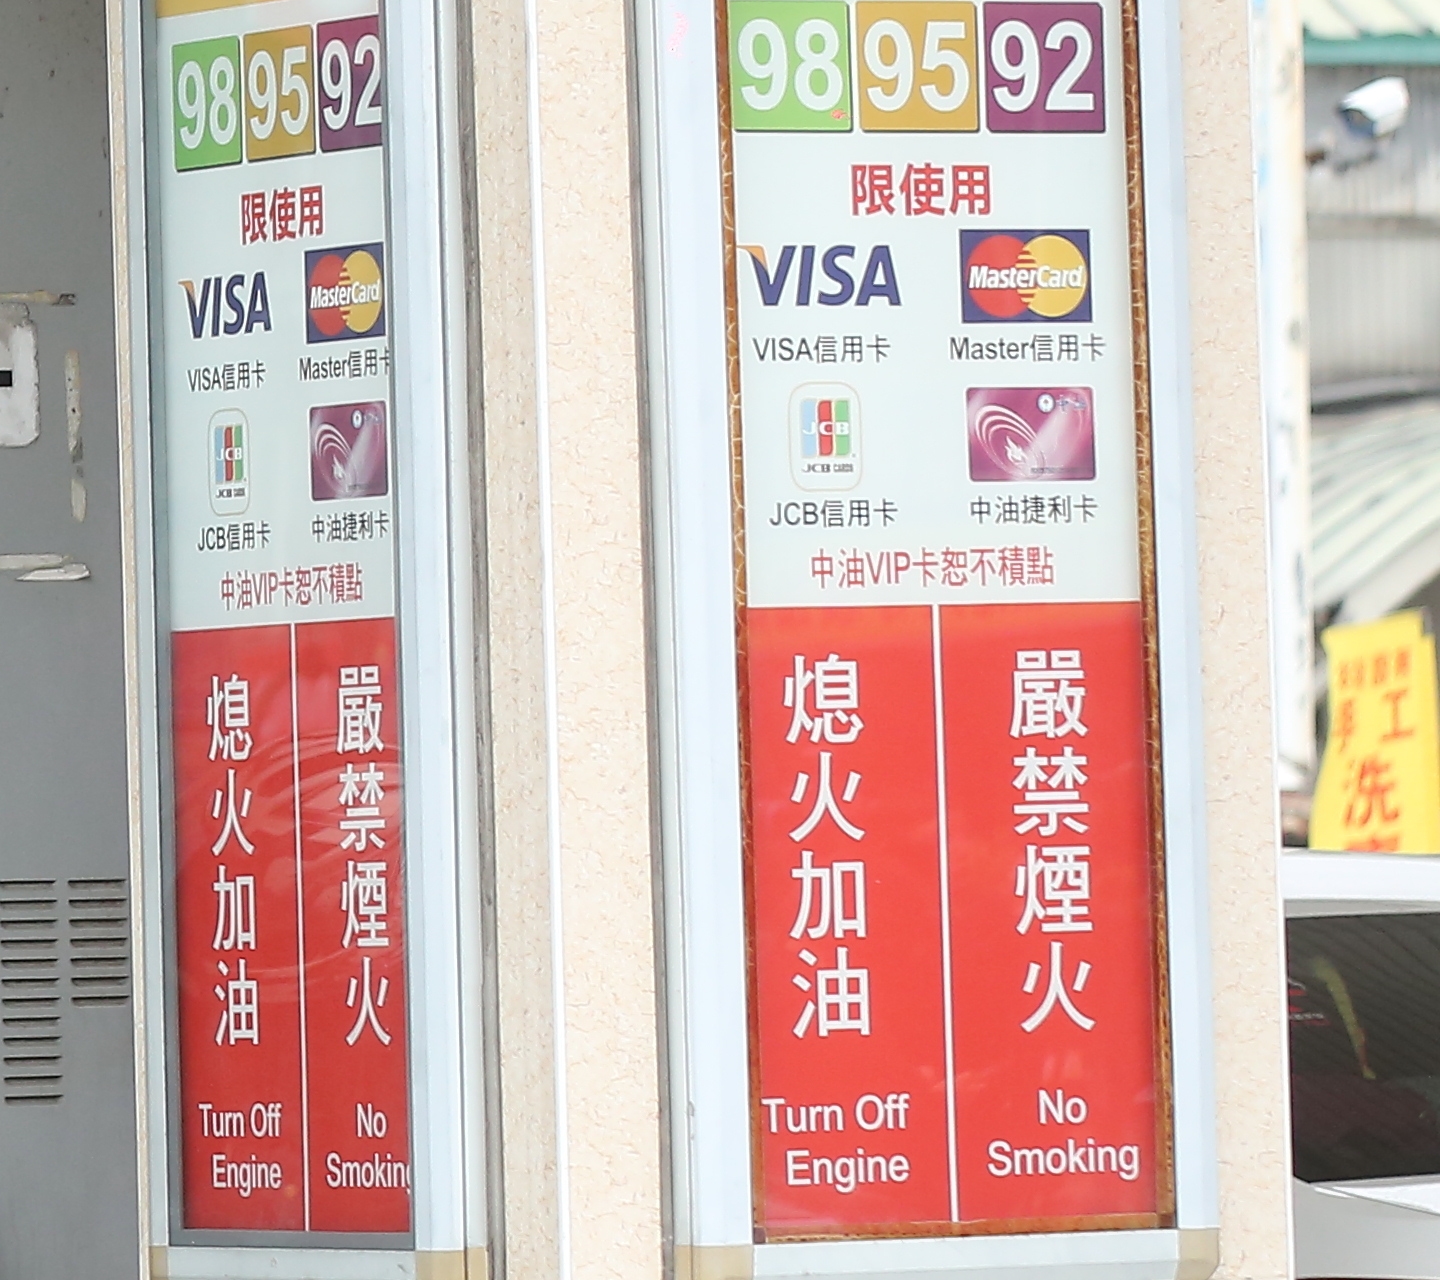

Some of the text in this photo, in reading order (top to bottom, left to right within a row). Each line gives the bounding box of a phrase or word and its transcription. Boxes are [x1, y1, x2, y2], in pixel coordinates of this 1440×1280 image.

[737, 18, 1095, 111] 98 95 92
[177, 32, 382, 151] 98 95 92
[850, 163, 992, 217] 限使用
[240, 186, 325, 246] 限使用
[309, 276, 380, 312] MasterCard
[737, 244, 902, 307] VISA
[967, 262, 1083, 292] MasterCard
[180, 271, 272, 340] VISA
[752, 335, 891, 364] VISA信用卡
[949, 334, 1106, 362] Master信用卡
[186, 361, 266, 393] VISA信用卡
[803, 420, 850, 437] JCB
[216, 446, 242, 463] JCB
[801, 463, 831, 474] JCB
[311, 510, 389, 545] 中油捷利卡
[769, 499, 898, 528] JCB信用卡
[969, 495, 1098, 524] 中油捷利卡
[197, 521, 271, 553] JCB信用卡
[810, 545, 1055, 588] 中油VIP卡恕不積點
[221, 561, 363, 611] 中油VIP卡恕不積點
[206, 672, 260, 1047] 熄火加油
[336, 665, 393, 1047] 嚴禁煙火
[782, 652, 873, 1040] 熄火加油
[1009, 649, 1096, 1034] 嚴禁煙火
[199, 1102, 282, 1138] Turn Off
[356, 1104, 387, 1138] No
[762, 1094, 909, 1132] Turn Off
[1038, 1089, 1086, 1125] No
[212, 1153, 282, 1197] Engine
[786, 1150, 909, 1195] Engine
[987, 1138, 1140, 1181] Smoking
